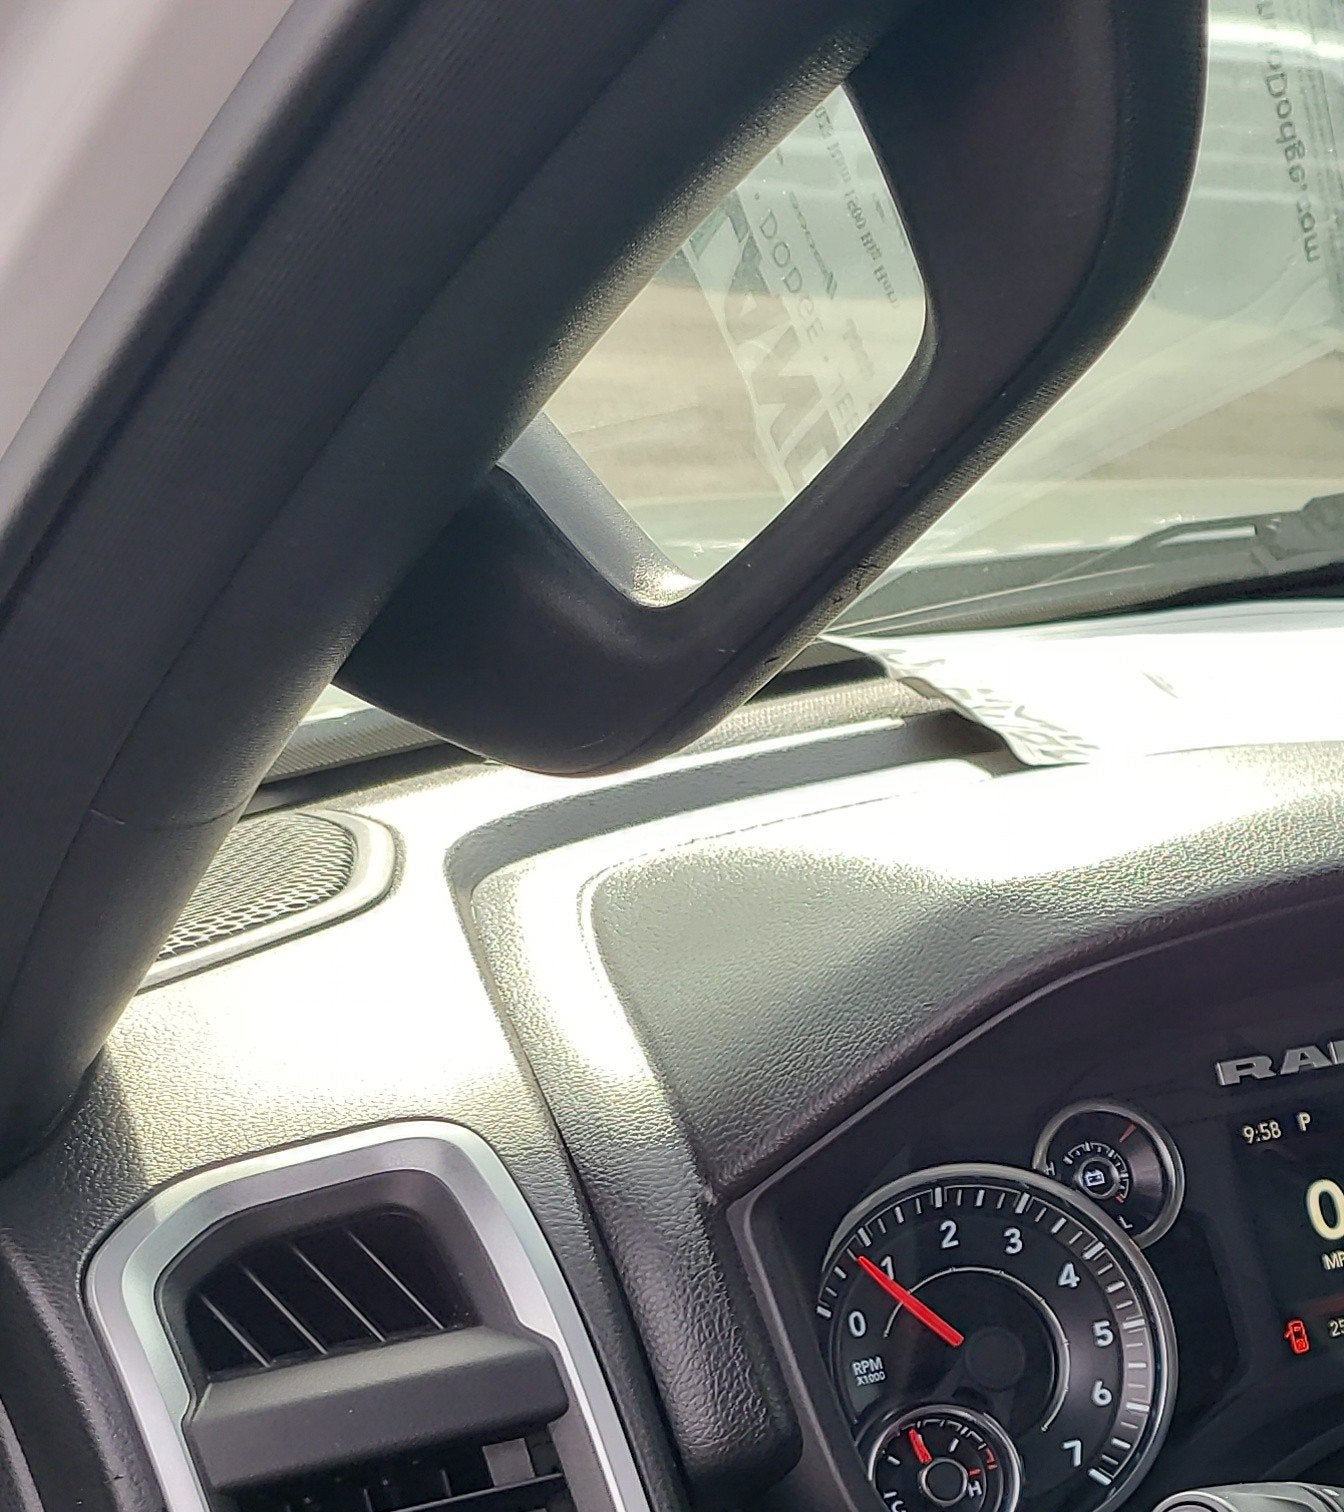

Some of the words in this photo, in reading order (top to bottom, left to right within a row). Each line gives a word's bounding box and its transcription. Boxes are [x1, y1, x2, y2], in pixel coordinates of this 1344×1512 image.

[1242, 1120, 1282, 1144] 9:58
[1297, 1111, 1311, 1132] P
[939, 1220, 960, 1250] 2
[1003, 1227, 1024, 1255] 3
[1057, 1262, 1082, 1290] 4
[848, 1310, 867, 1338] 0
[1092, 1320, 1115, 1347] 5
[851, 1356, 884, 1376] RPM
[1091, 1381, 1113, 1407] 6
[1062, 1438, 1083, 1468] 7
